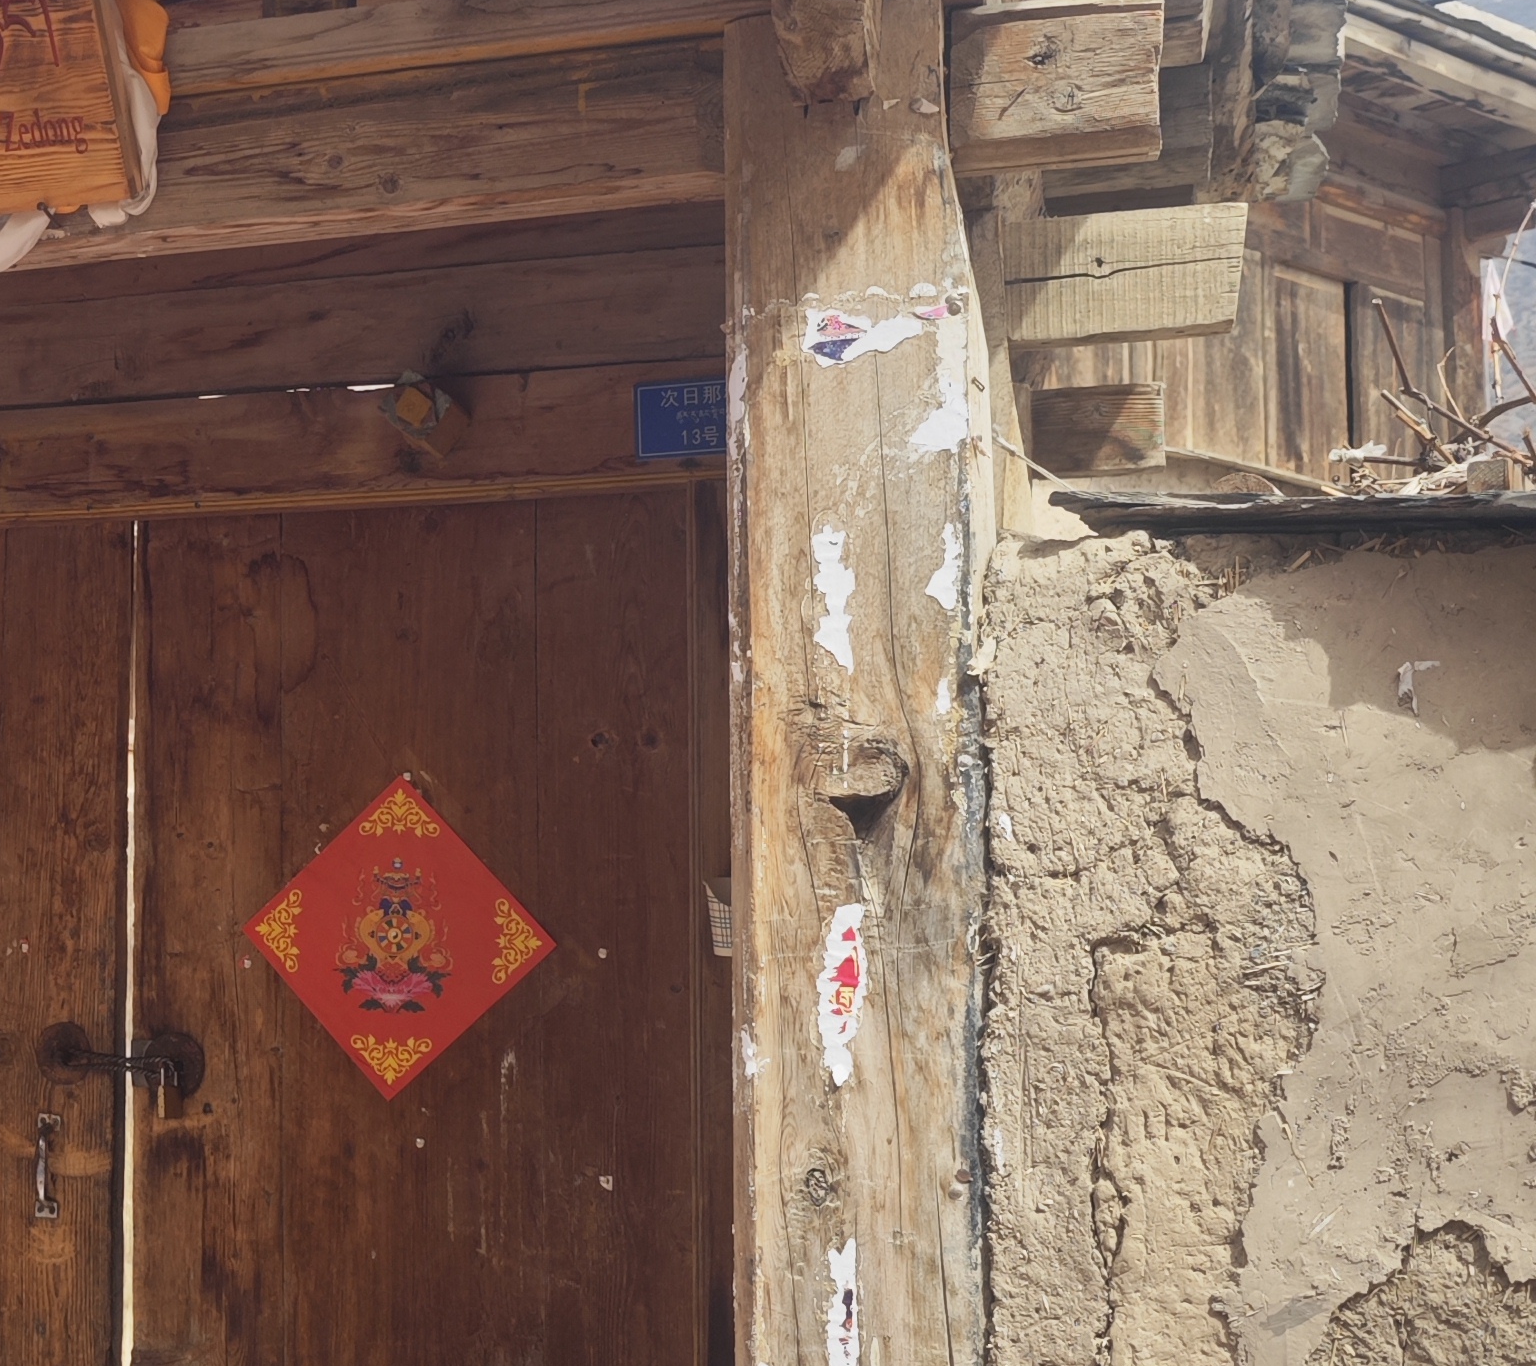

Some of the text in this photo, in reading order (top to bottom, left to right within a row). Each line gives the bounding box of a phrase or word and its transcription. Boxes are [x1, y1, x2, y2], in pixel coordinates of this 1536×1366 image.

[1, 108, 89, 154] Zedong
[660, 385, 726, 408] 次日那
[680, 426, 720, 446] 13号
